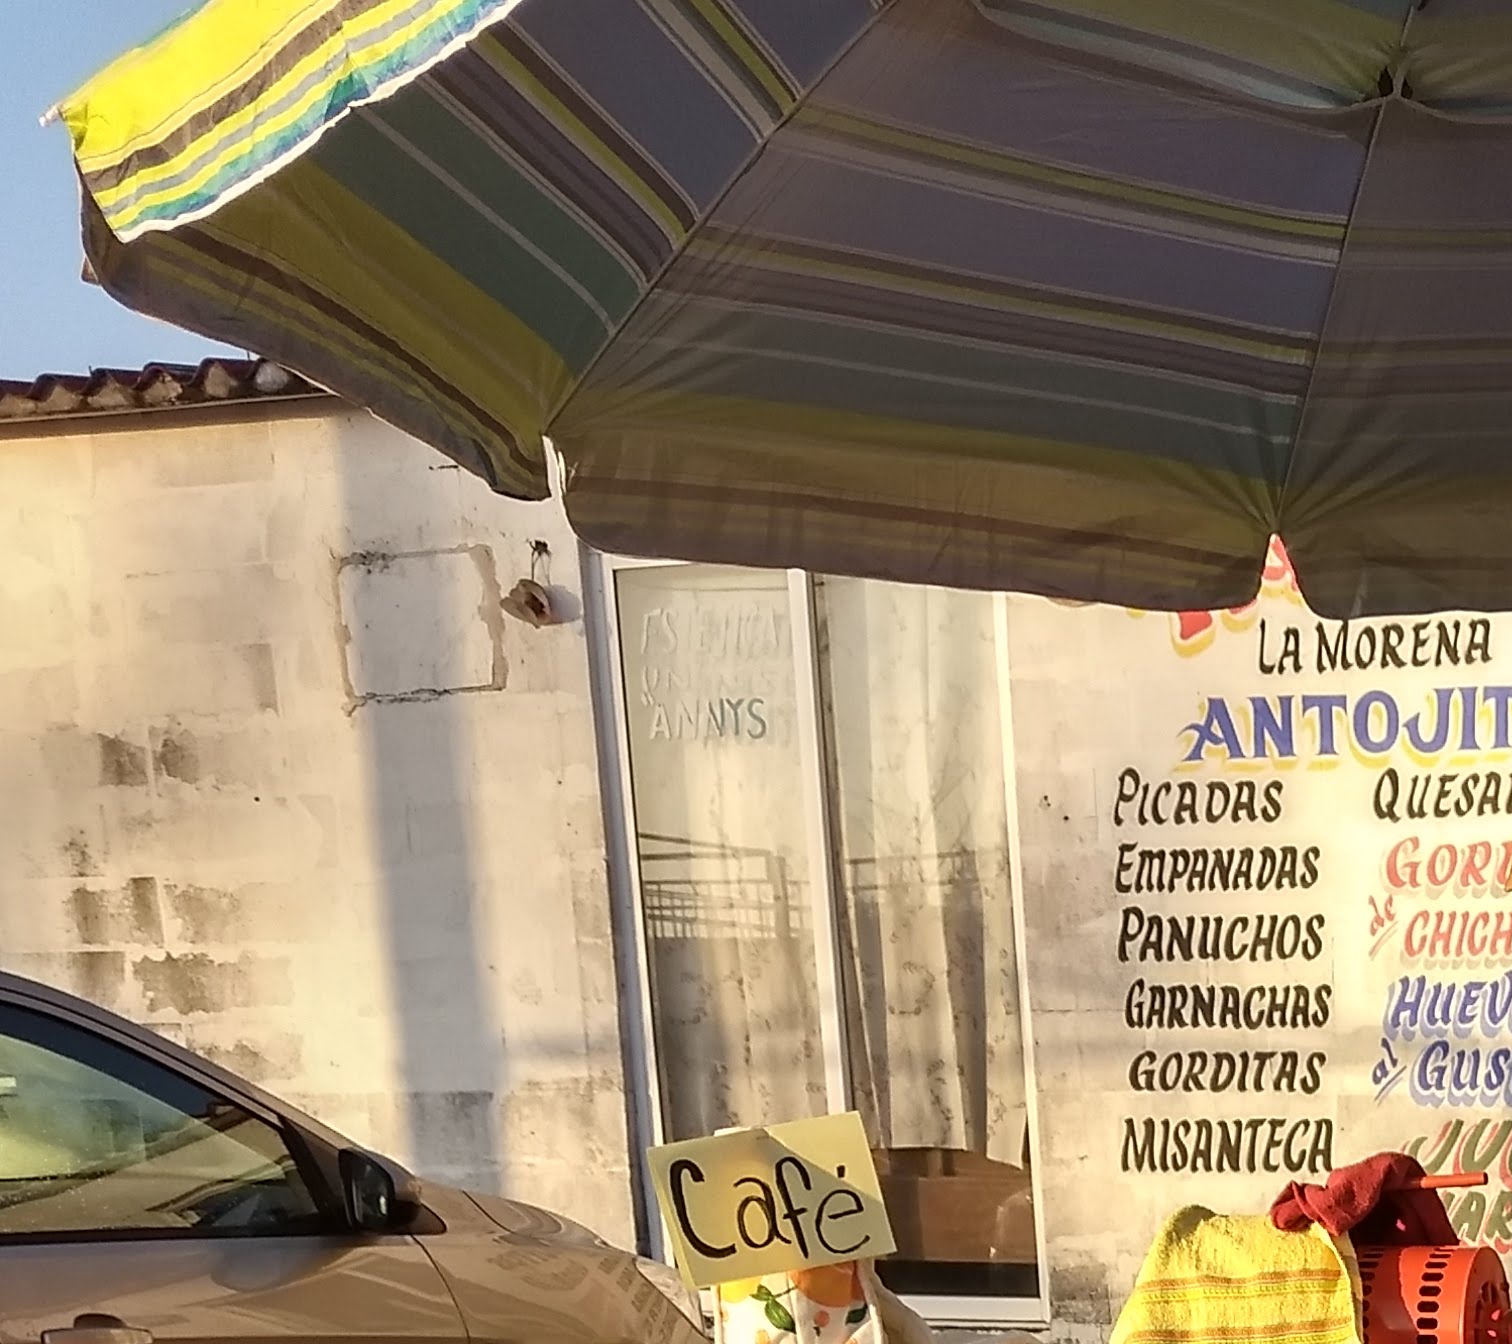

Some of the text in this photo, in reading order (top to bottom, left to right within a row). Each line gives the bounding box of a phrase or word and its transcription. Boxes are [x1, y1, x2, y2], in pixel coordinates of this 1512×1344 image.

[1258, 619, 1493, 674] LA MORENA
[1114, 767, 1284, 827] PICADAS
[1115, 841, 1321, 893] EMPANADAS
[1118, 906, 1326, 962] PANUCHOS
[1125, 977, 1333, 1030] GARNACHAS
[1128, 1050, 1327, 1095] GORDITAS
[1121, 1116, 1334, 1174] MISANTECA
[669, 1156, 871, 1260] Café
